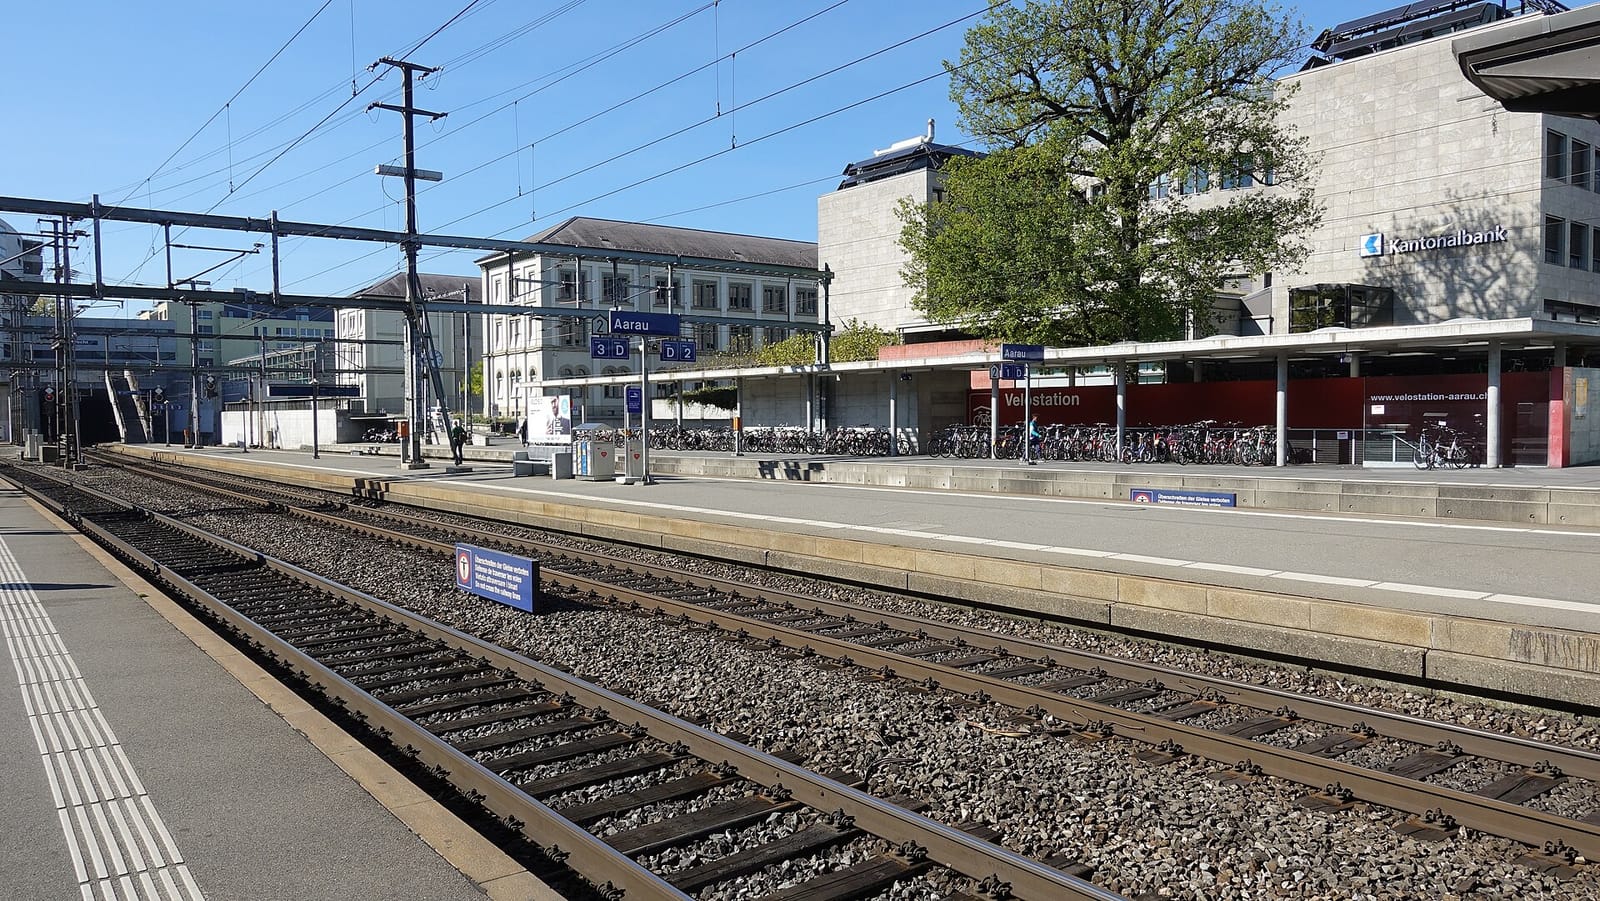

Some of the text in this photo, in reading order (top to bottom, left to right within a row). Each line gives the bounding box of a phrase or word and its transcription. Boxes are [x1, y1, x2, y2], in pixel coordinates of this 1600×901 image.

[1389, 226, 1508, 254] Kantonalbank
[597, 320, 603, 332] 2
[614, 318, 649, 331] Aarau
[597, 343, 624, 356] 3 D
[666, 347, 691, 358] D 2
[1004, 349, 1026, 358] Aarau
[1017, 369, 1022, 377] D
